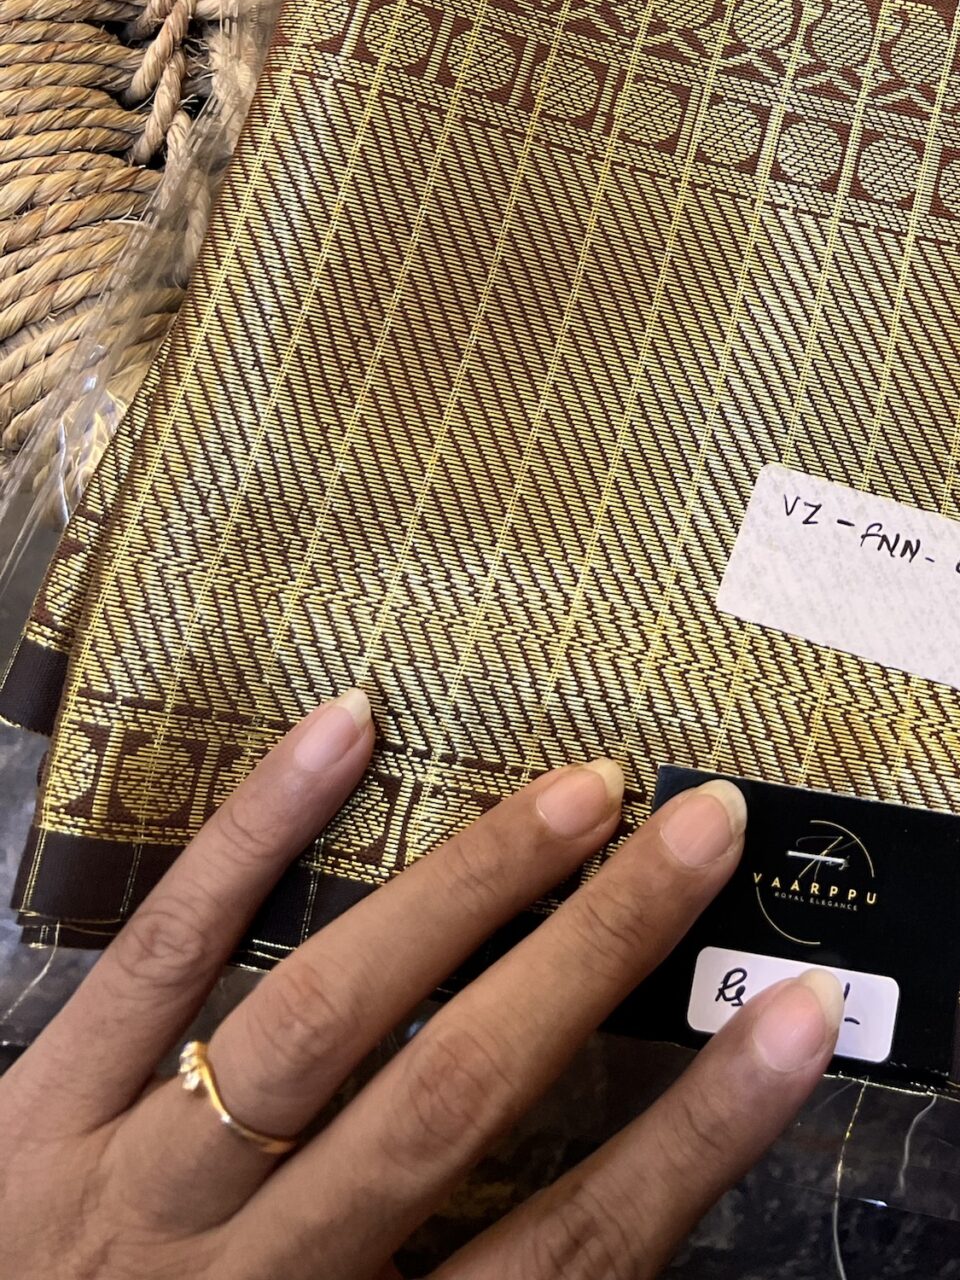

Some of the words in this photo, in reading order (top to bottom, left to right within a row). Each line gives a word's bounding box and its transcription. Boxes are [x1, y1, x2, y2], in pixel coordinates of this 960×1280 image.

[753, 872, 877, 904] VAARPPU
[774, 891, 805, 903] ROYAL
[809, 896, 858, 912] ELEGANCE
